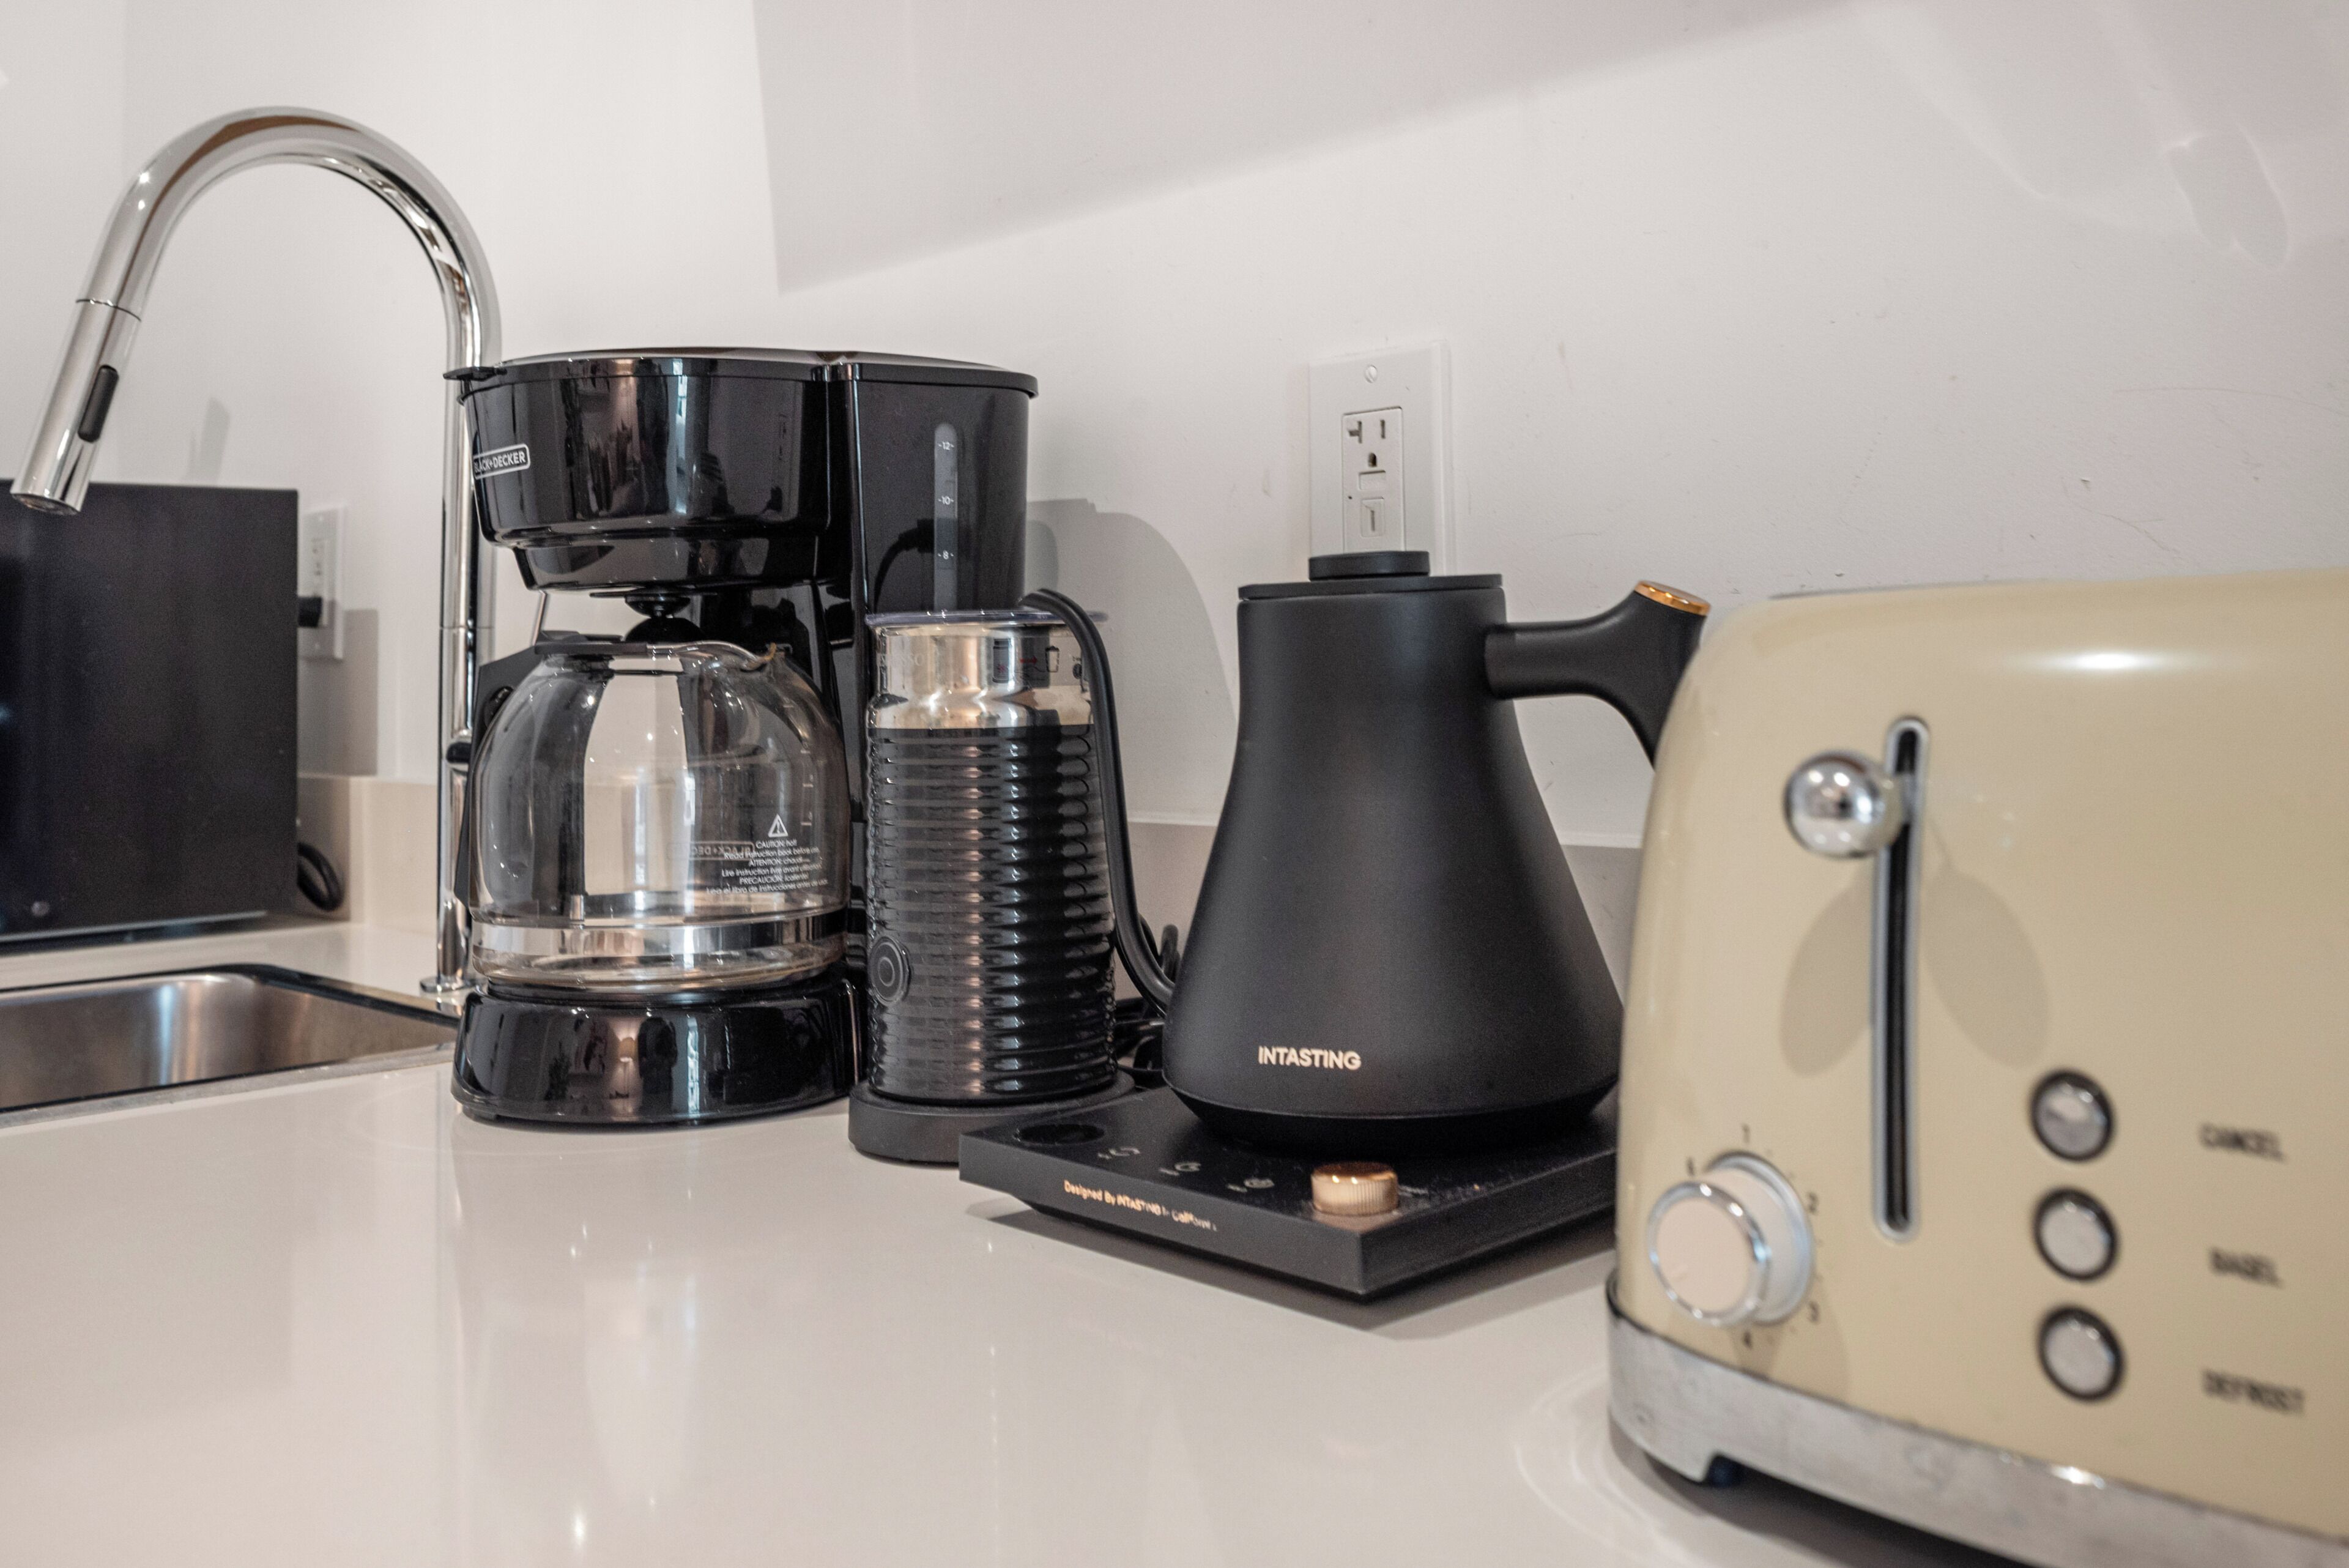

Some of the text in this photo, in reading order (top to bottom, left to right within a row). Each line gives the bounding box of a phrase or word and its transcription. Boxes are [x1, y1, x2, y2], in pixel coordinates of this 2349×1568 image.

[1258, 1046, 1362, 1071] INTASTING
[1064, 1179, 1103, 1202] Designed
[1104, 1190, 1116, 1206] By
